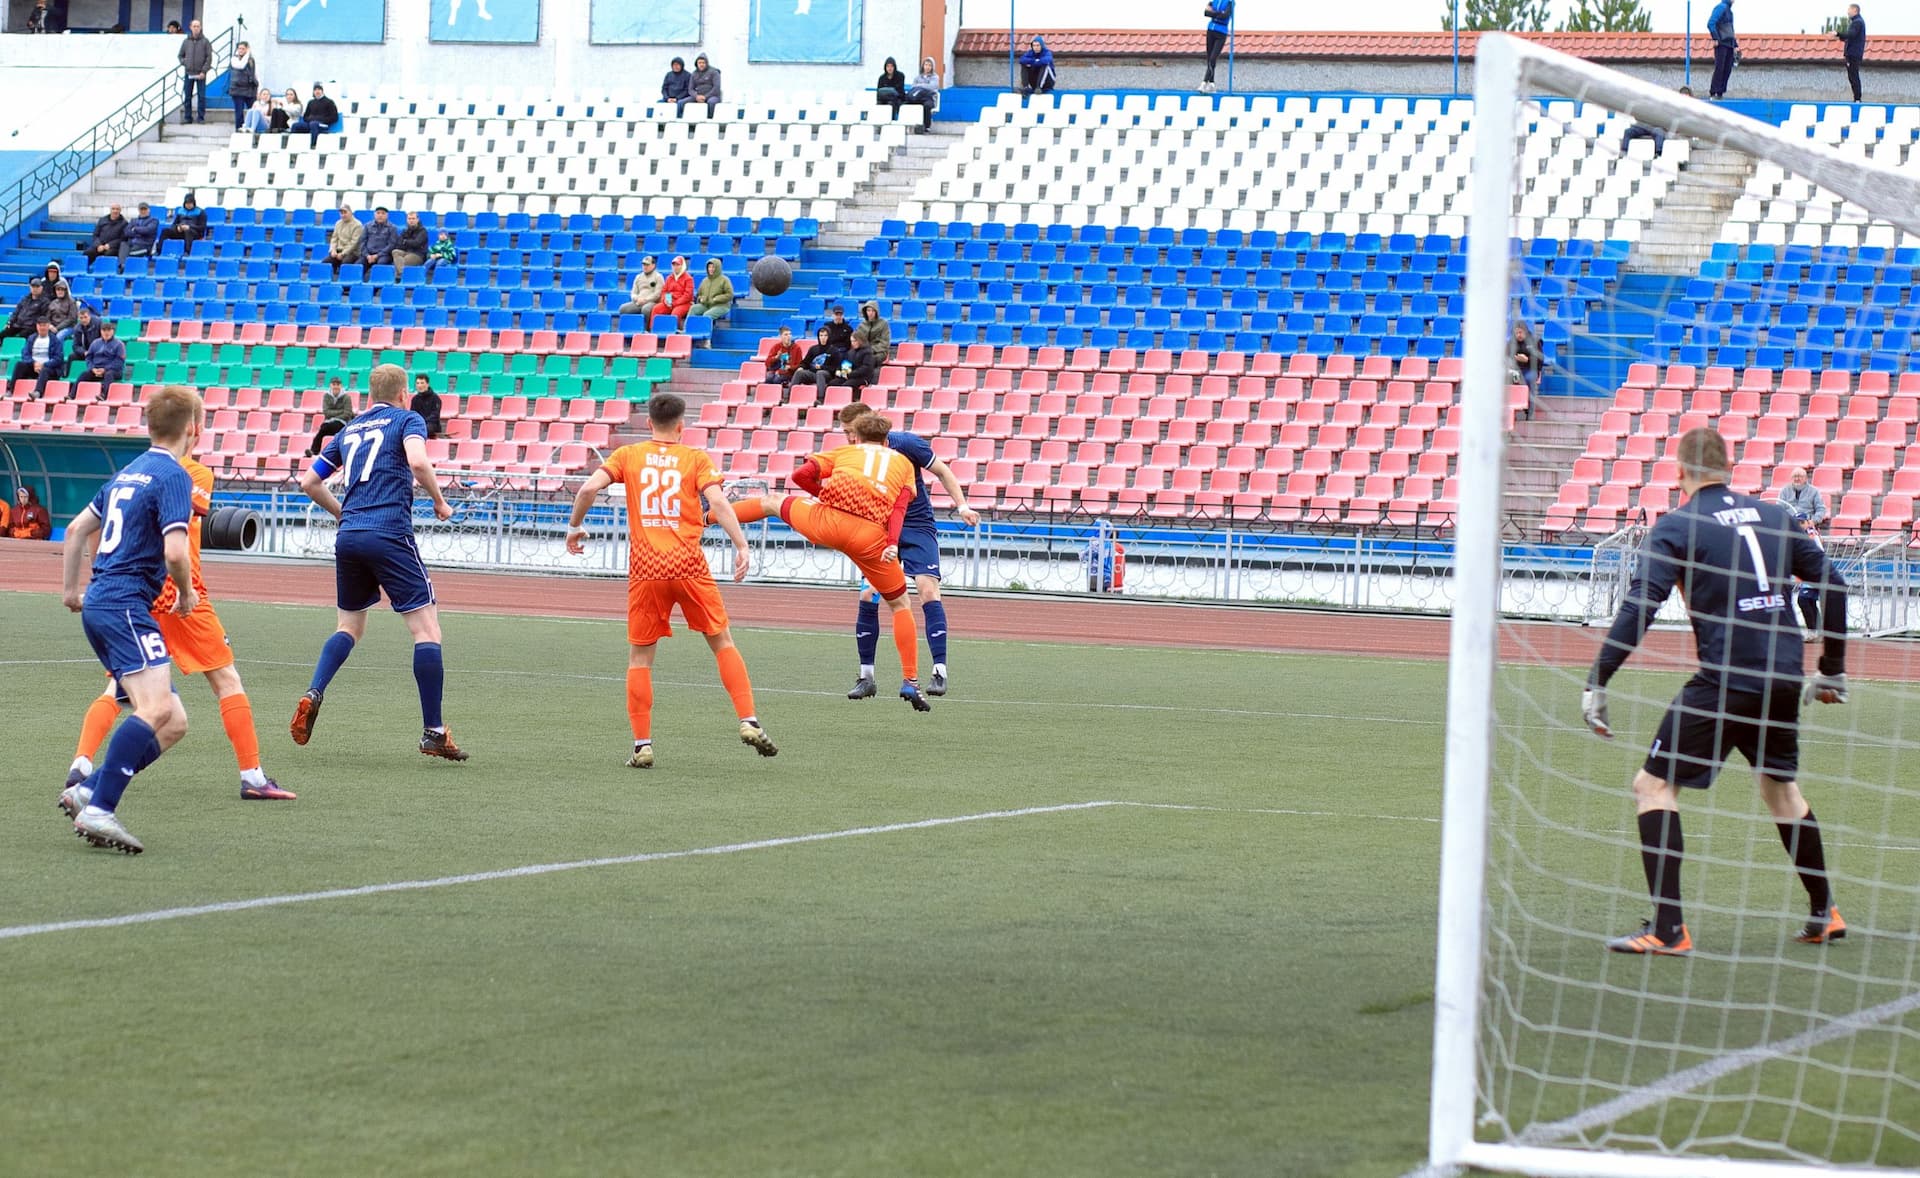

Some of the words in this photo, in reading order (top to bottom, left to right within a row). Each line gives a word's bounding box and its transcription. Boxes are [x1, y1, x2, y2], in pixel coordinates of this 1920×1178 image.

[343, 429, 384, 487] 77
[863, 447, 890, 482] 11
[640, 467, 682, 517] 22
[641, 518, 680, 530] SEUS
[1736, 526, 1770, 592] 1
[1738, 595, 1786, 612] SEUS
